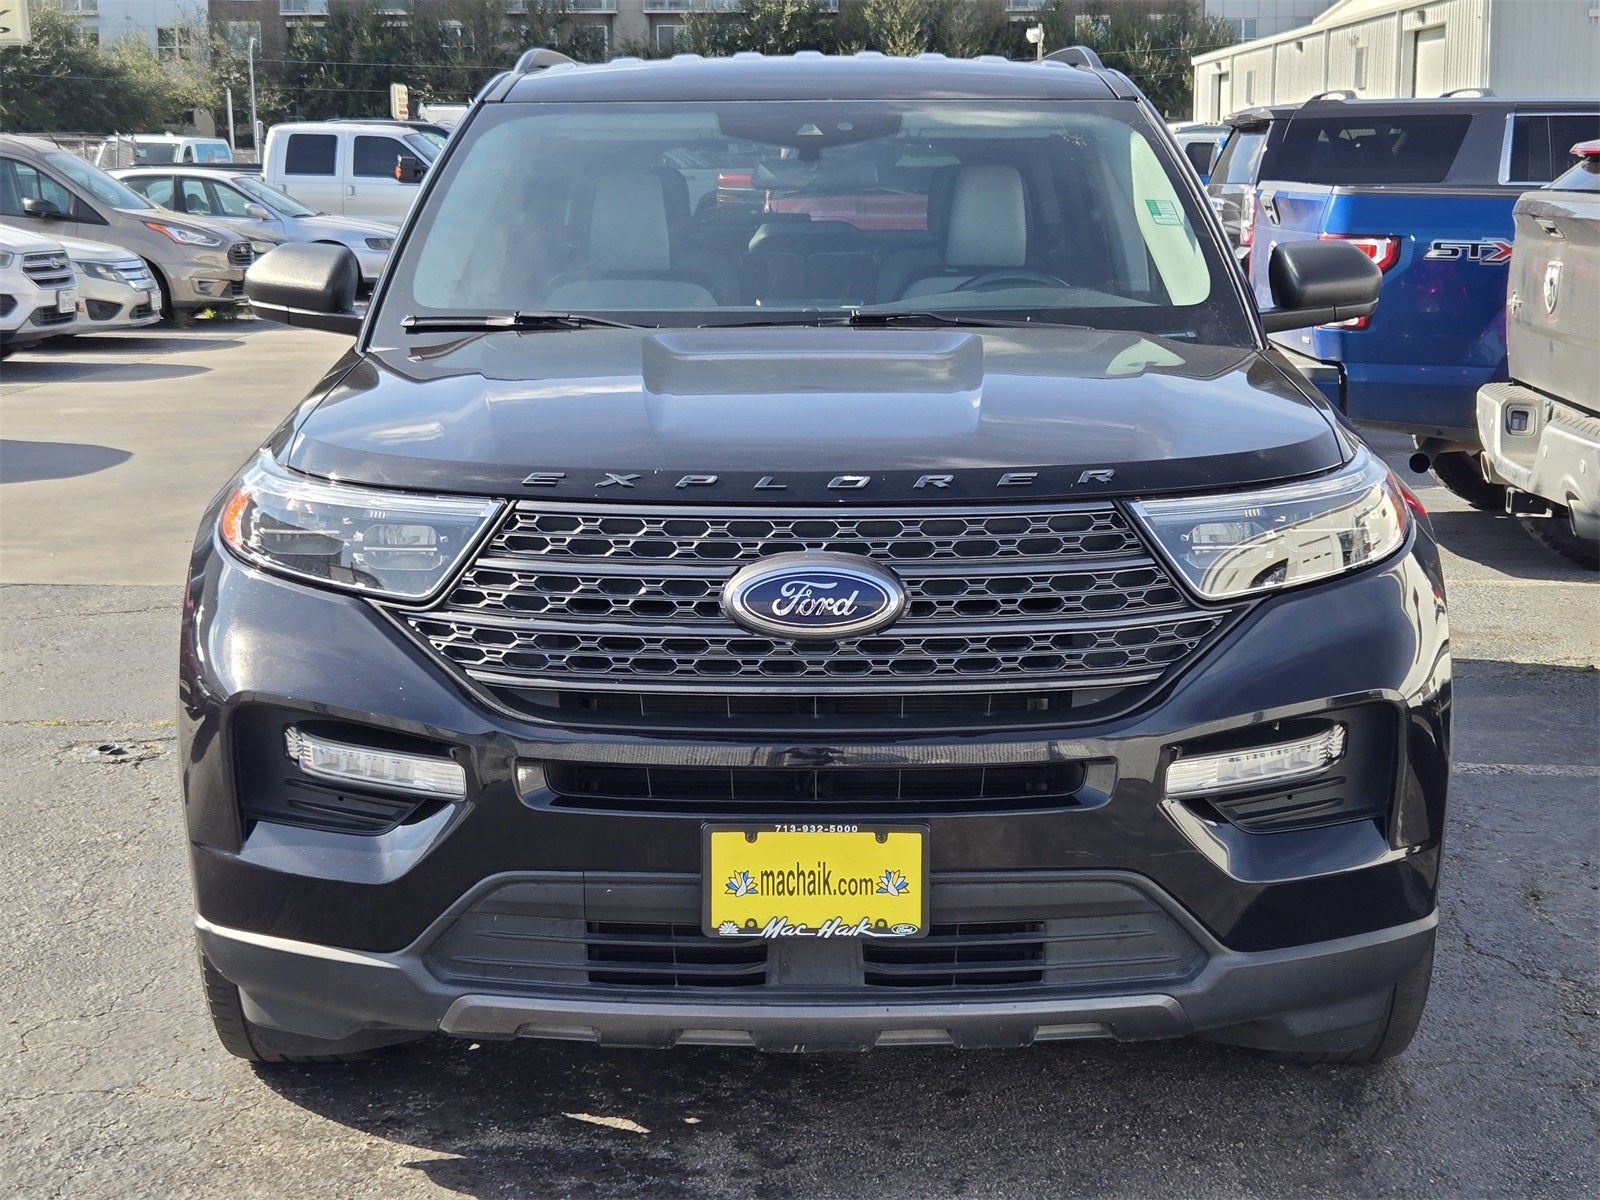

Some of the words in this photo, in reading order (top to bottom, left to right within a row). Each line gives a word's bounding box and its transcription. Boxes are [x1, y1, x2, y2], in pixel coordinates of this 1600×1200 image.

[1424, 237, 1514, 265] STX
[521, 468, 1115, 490] EXPLORER
[771, 580, 860, 616] Ford
[774, 824, 859, 833] 713-932-5000
[760, 861, 874, 896] machaik.com
[762, 916, 816, 938] Mac
[818, 916, 875, 938] Haik
